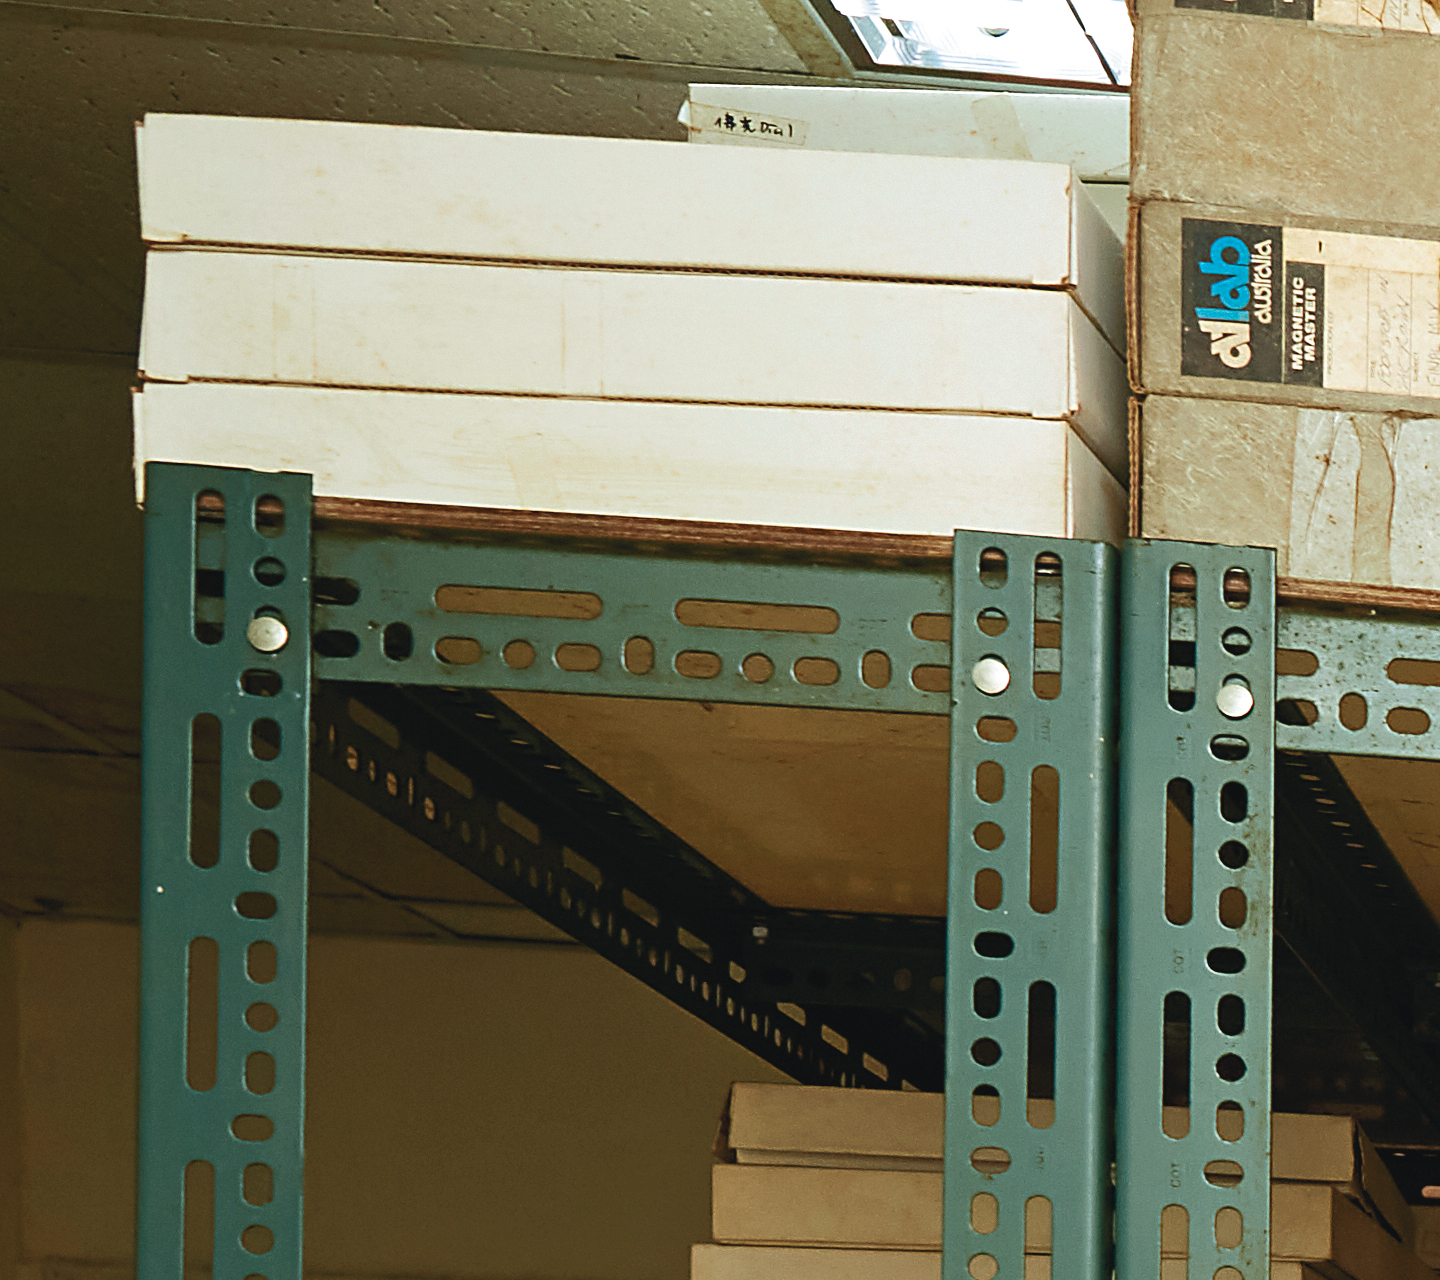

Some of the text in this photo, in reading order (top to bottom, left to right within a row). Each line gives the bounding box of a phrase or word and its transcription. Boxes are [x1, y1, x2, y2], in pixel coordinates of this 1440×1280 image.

[1251, 239, 1272, 324] australia
[1291, 277, 1304, 371] MAGNETIC
[1304, 287, 1316, 362] MASTER
